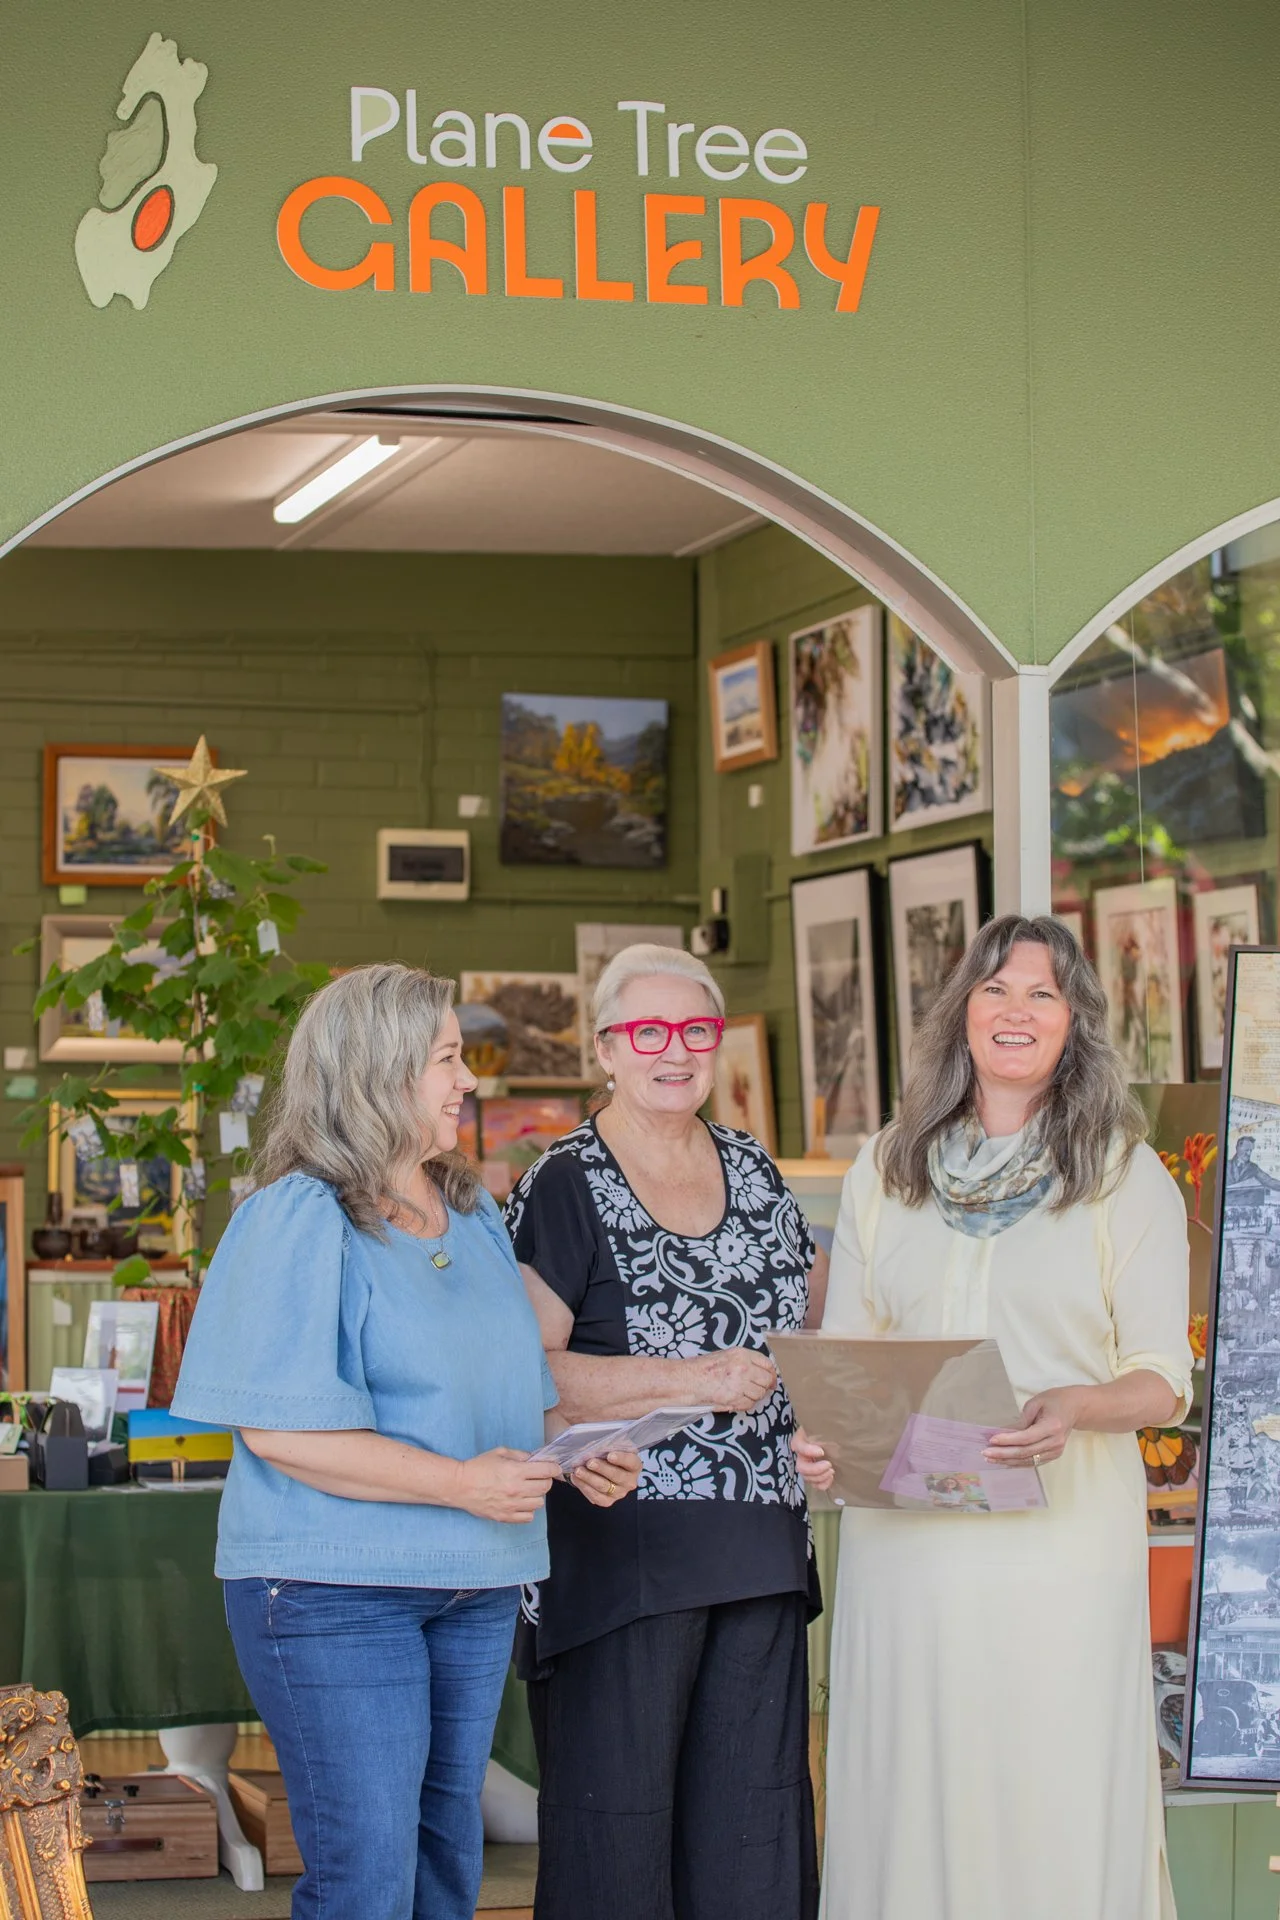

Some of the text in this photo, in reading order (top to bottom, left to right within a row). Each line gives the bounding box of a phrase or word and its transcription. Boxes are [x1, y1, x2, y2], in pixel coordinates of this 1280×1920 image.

[350, 86, 808, 184] Plane Tree
[276, 176, 880, 313] GALLERY
